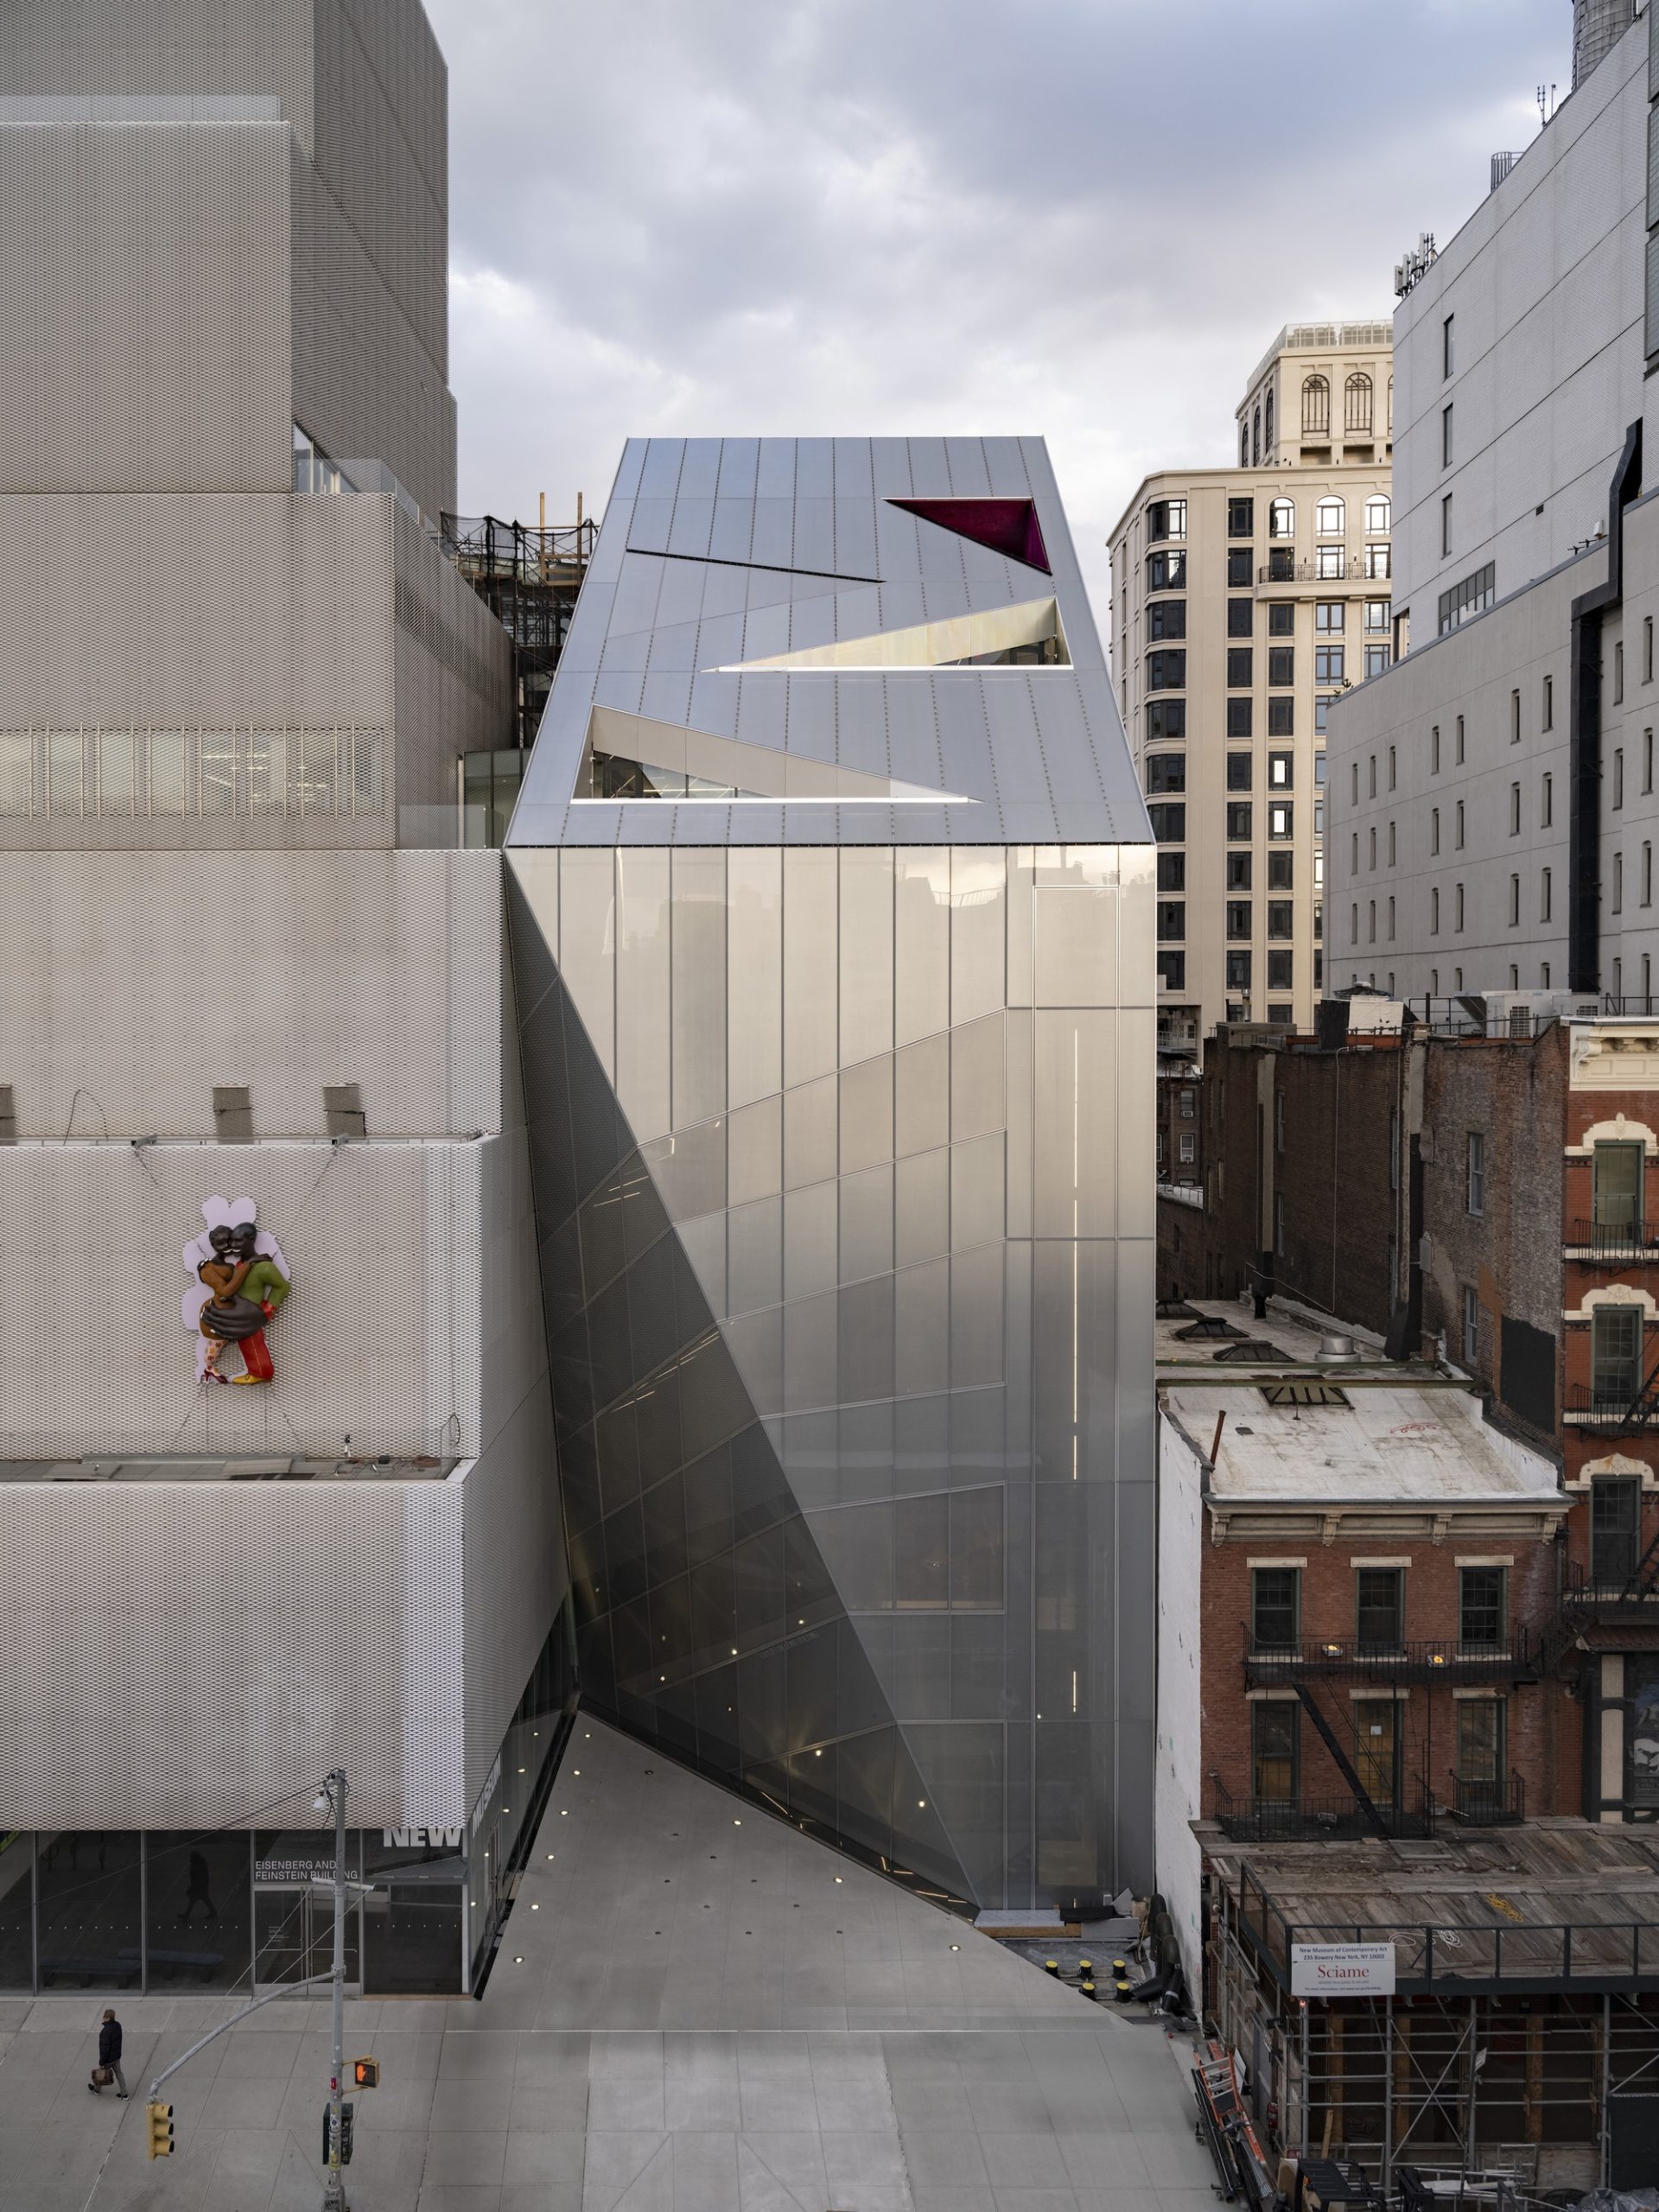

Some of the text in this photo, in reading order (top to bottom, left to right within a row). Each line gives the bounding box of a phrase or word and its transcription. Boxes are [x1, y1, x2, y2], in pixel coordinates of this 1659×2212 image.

[383, 1827, 462, 1847] NEW
[255, 1860, 337, 1870] EISENBERG AND
[255, 1870, 358, 1880] FEINSTEIN BUILNG
[1317, 1964, 1370, 1978] Sciame
